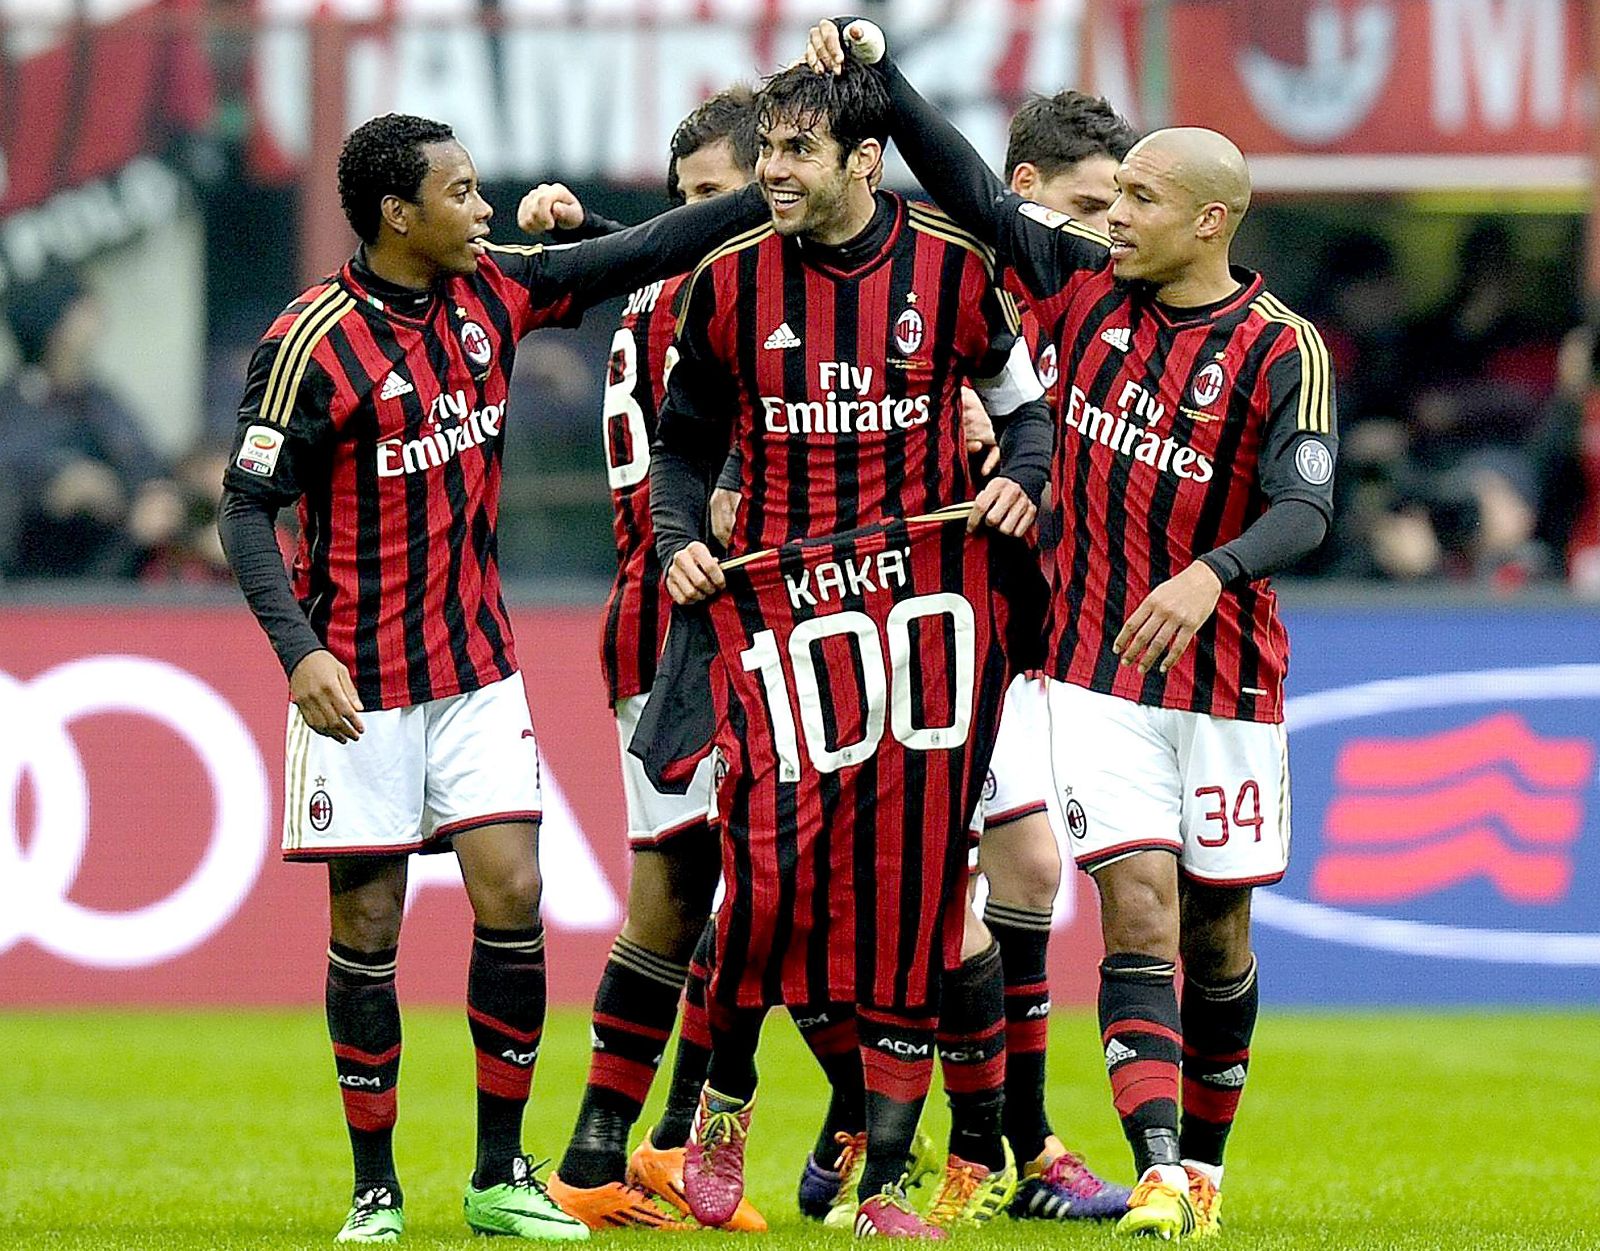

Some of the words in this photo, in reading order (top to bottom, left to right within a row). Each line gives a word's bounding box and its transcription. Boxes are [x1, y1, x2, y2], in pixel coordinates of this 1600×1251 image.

[818, 360, 873, 396] Fly
[427, 389, 469, 424] Fly
[760, 390, 931, 435] Emirates
[1117, 379, 1166, 429] Fly
[1064, 384, 1214, 484] Emirates
[740, 592, 976, 783] 100
[1194, 779, 1265, 848] 34
[877, 1037, 929, 1055] ACM
[338, 1074, 381, 1087] ACM
